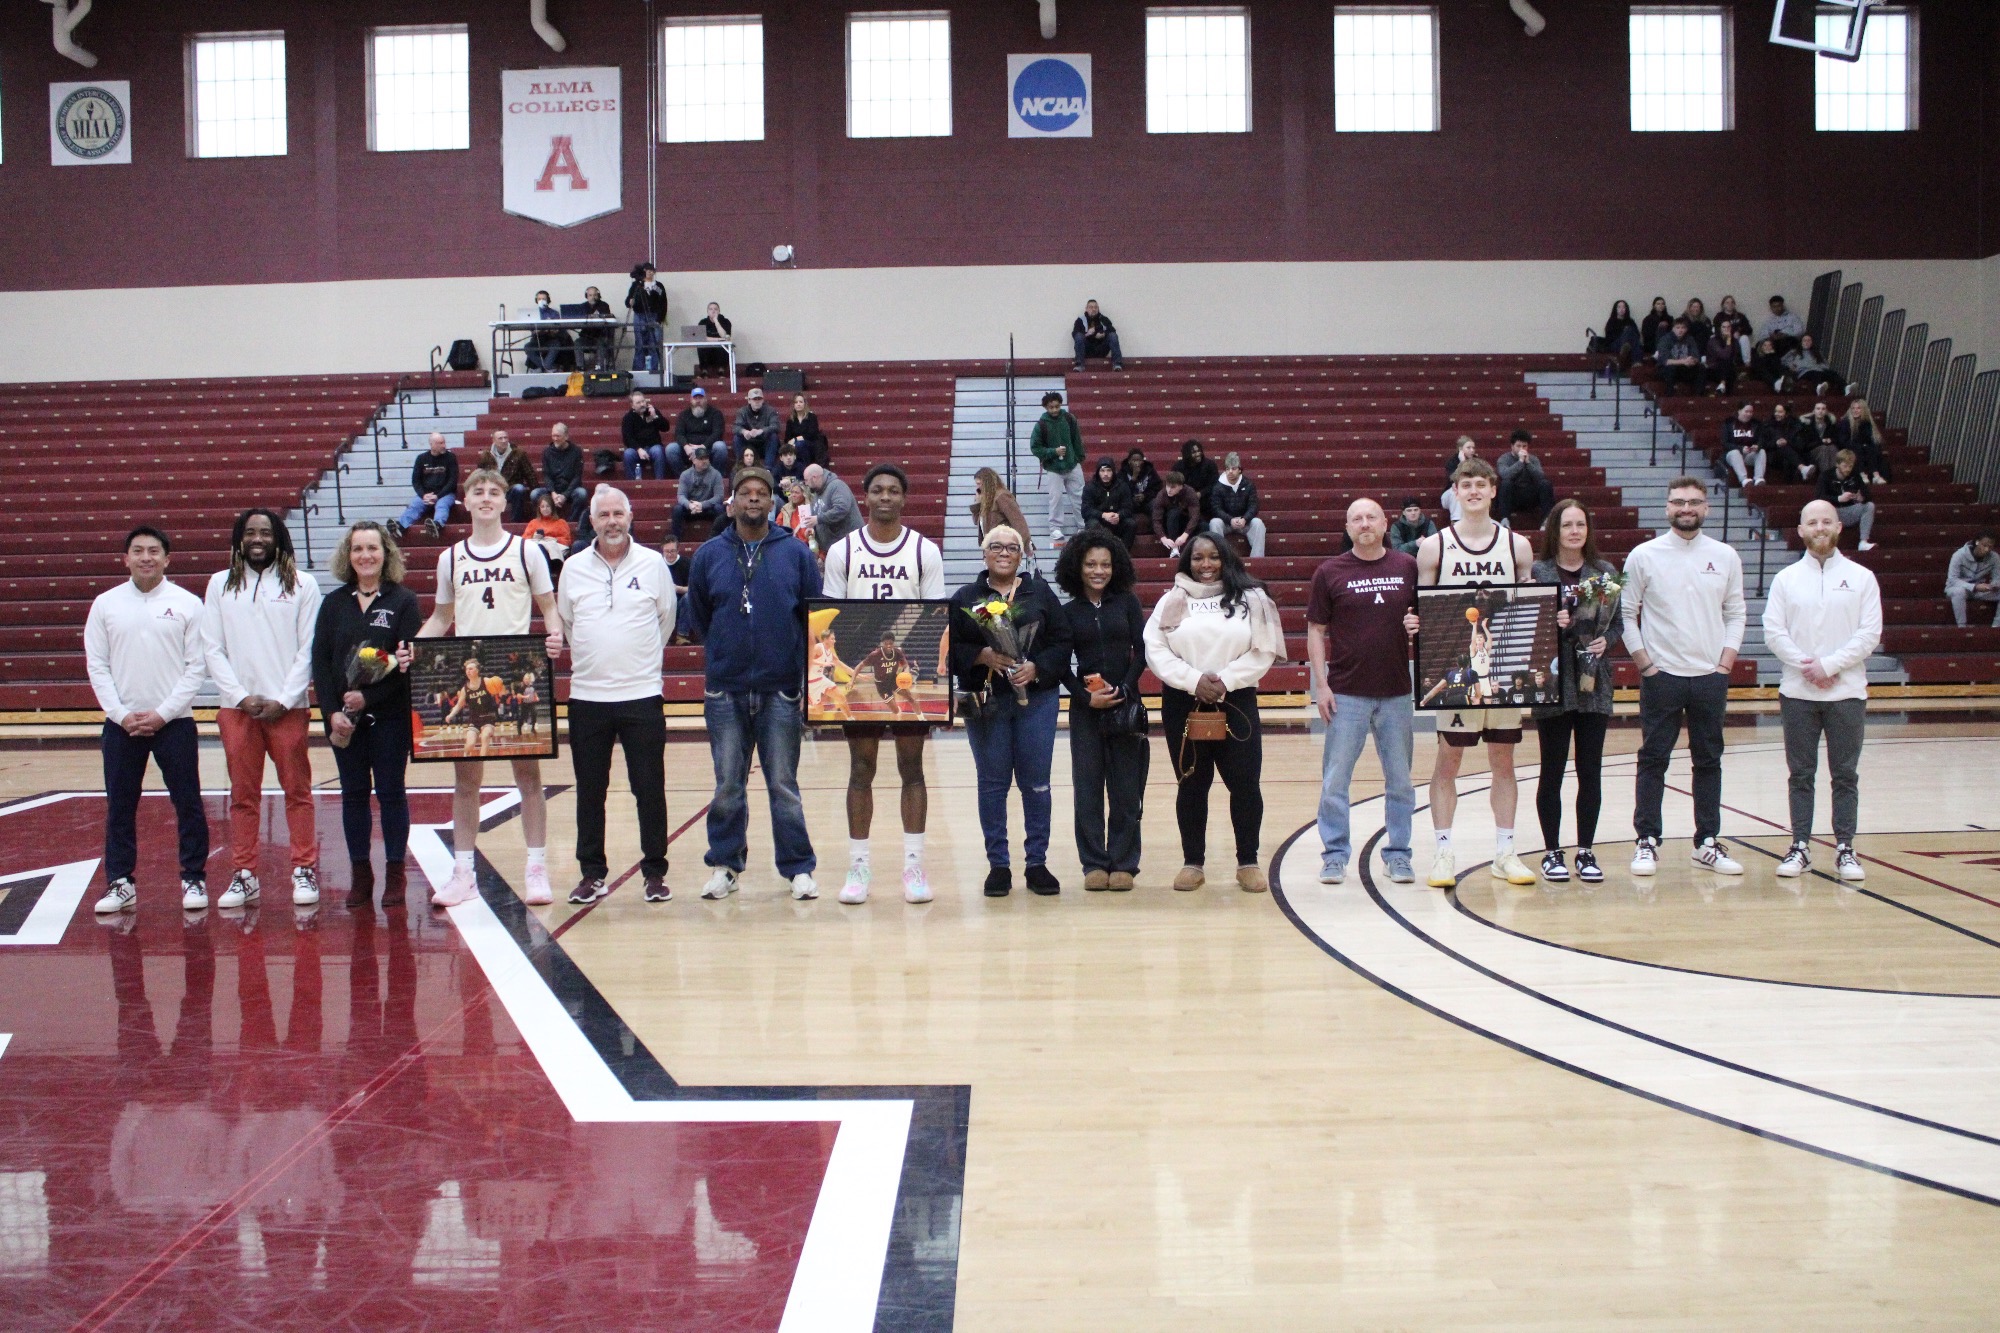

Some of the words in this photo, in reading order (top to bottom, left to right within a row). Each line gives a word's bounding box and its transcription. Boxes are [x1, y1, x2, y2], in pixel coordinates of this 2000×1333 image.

[528, 81, 594, 95] ALMA
[508, 99, 616, 114] COLLEGE
[1020, 97, 1083, 116] NCAA
[71, 119, 111, 139] MIAA
[534, 135, 590, 192] A
[858, 564, 909, 580] ALMA
[1452, 561, 1505, 576] ALMA
[461, 568, 515, 586] ALMA
[627, 577, 640, 590] A
[1347, 579, 1372, 588] ALMA
[1372, 577, 1404, 585] COLLEGE
[872, 583, 893, 600] 12
[1355, 585, 1399, 593] BASKETBALL
[482, 587, 495, 609] 4
[1374, 592, 1385, 604] A
[164, 608, 173, 616] A
[1191, 601, 1219, 611] PAR
[1451, 713, 1464, 727] A
